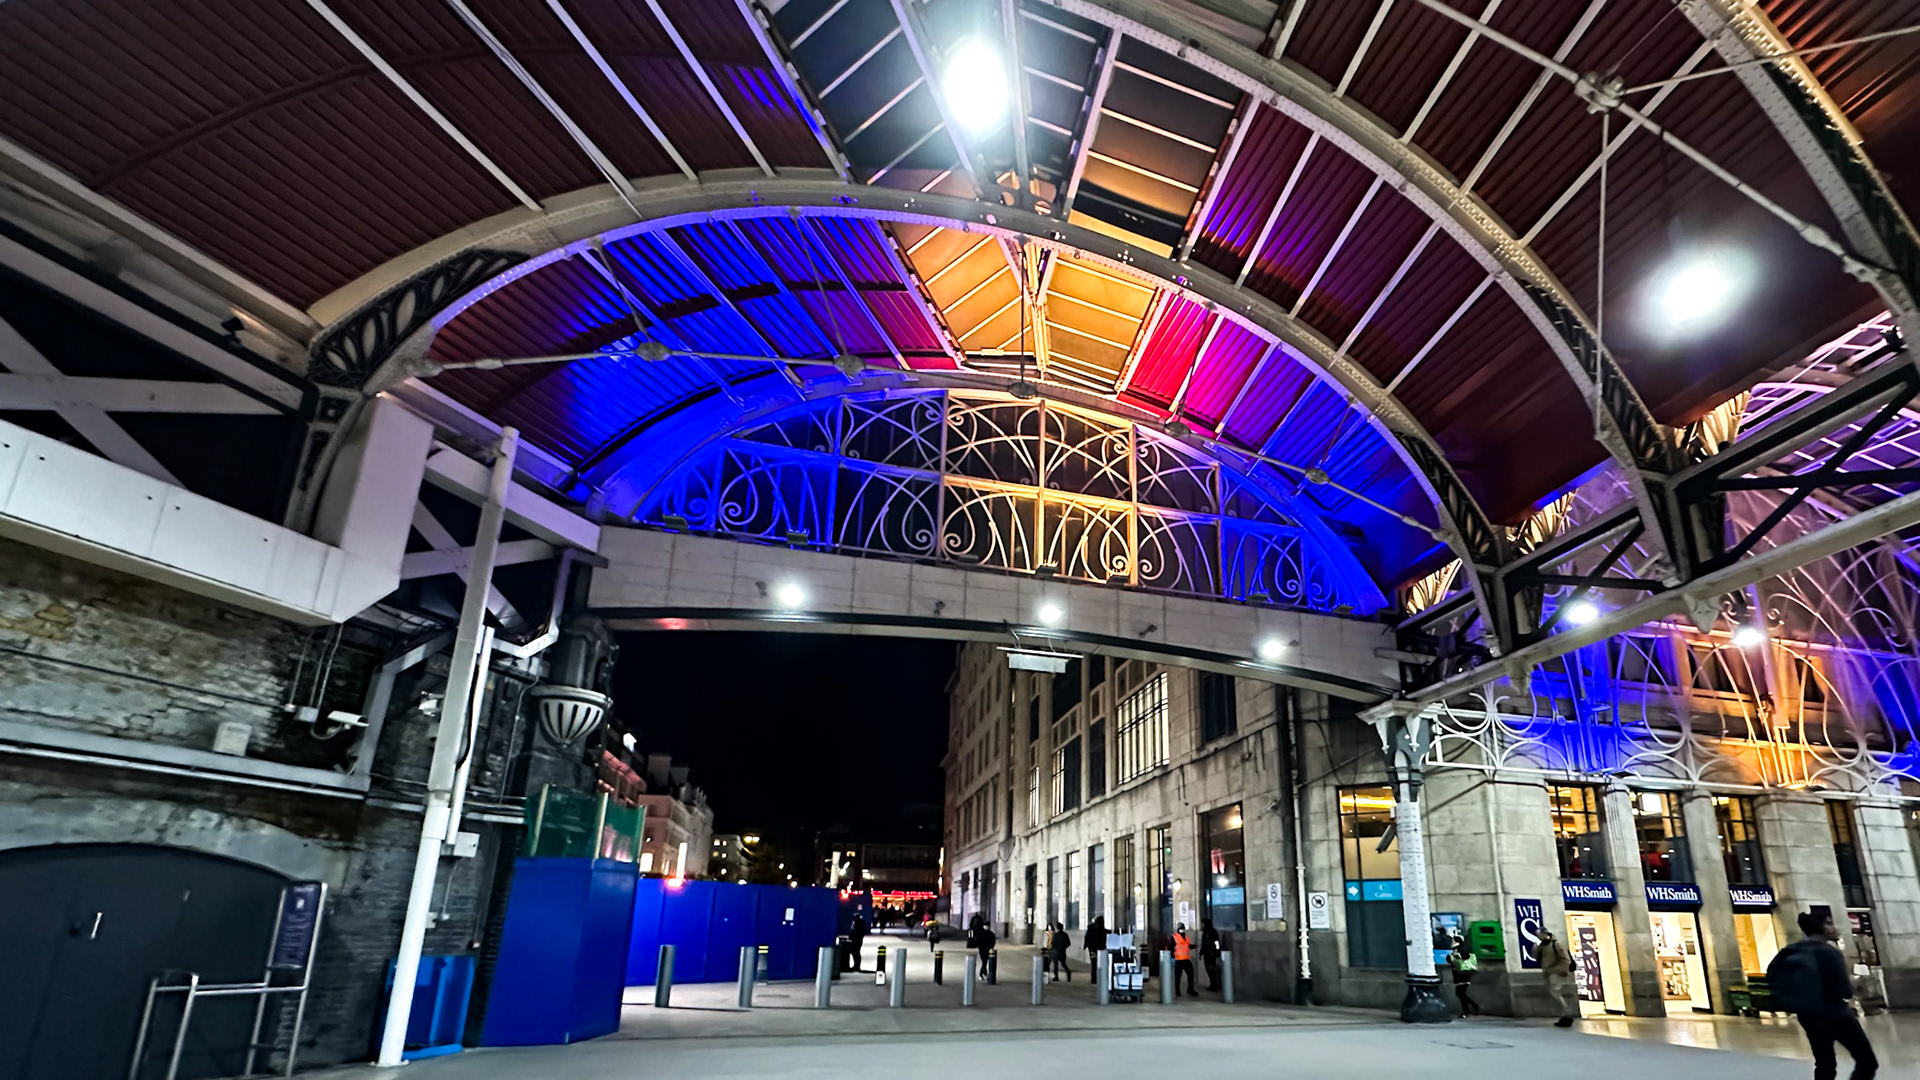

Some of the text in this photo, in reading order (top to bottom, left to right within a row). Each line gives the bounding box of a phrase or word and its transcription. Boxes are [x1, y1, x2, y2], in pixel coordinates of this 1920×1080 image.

[1563, 885, 1612, 899] WHSmith
[1646, 886, 1699, 901] WHSmith
[1729, 889, 1773, 902] WHSmith
[1517, 905, 1540, 918] WH
[1520, 918, 1542, 962] S
